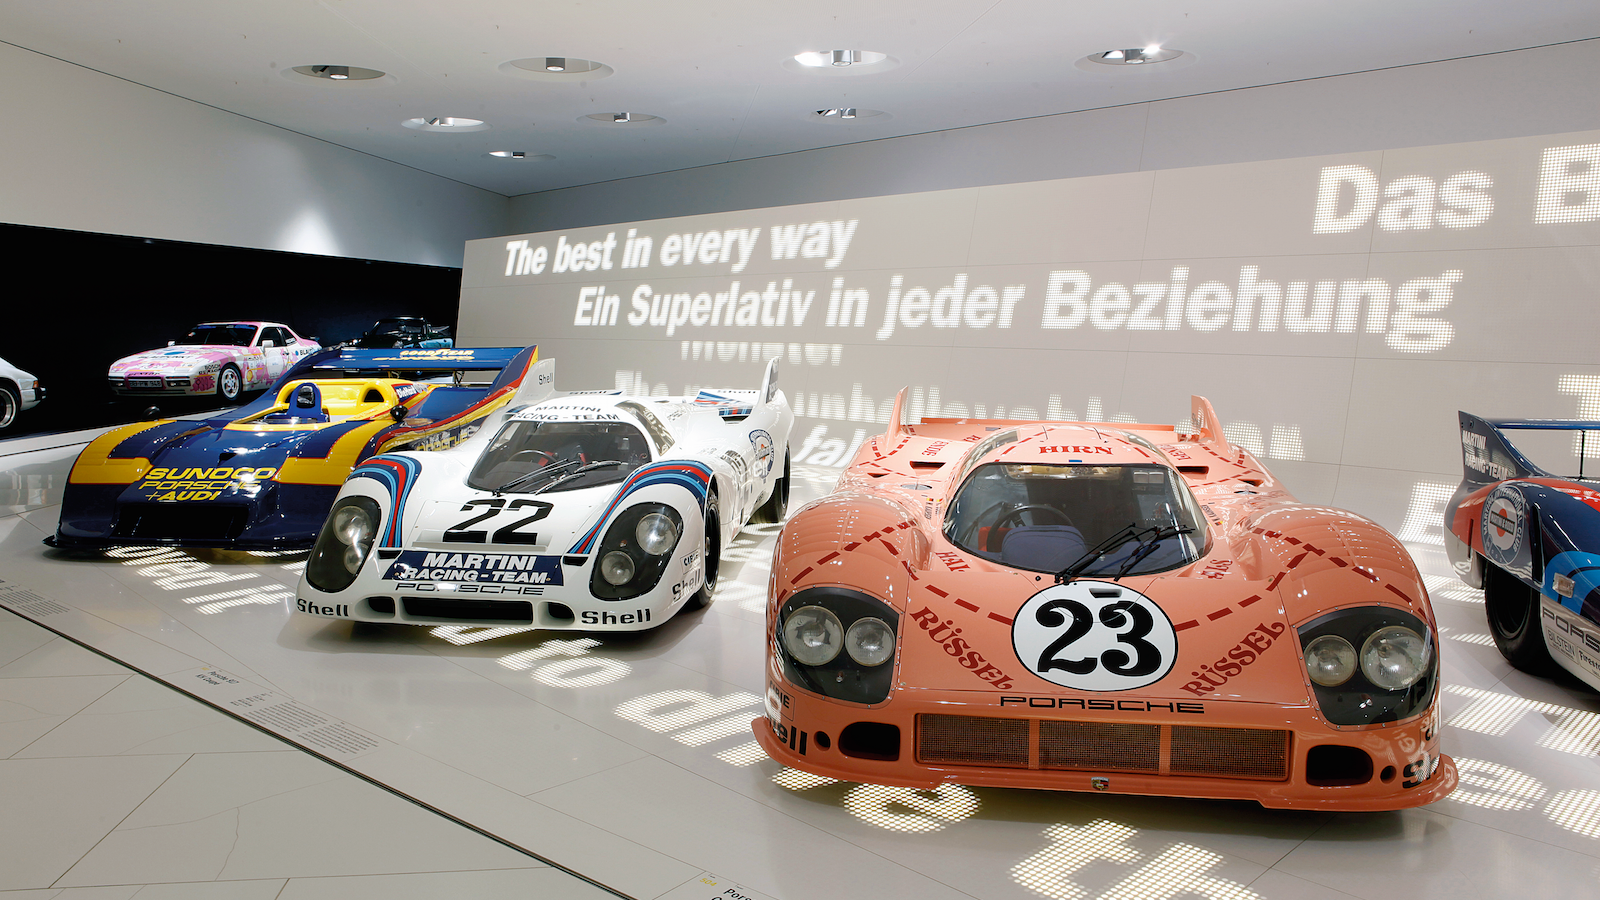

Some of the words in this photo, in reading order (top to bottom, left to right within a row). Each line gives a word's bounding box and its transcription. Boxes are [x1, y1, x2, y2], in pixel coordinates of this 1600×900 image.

[1312, 164, 1495, 234] Das
[504, 240, 548, 277] The
[552, 232, 616, 274] best
[621, 228, 653, 269] in
[660, 226, 761, 273] every
[770, 219, 859, 269] way
[574, 286, 620, 326] Ein
[627, 278, 815, 337] Superlativ
[825, 276, 869, 327] in
[875, 273, 1026, 341] jeder
[1040, 264, 1463, 353] Beziehung
[538, 374, 554, 386] Shell
[535, 405, 602, 413] MARTINI
[1462, 430, 1487, 450] MARTINI
[1038, 444, 1113, 456] HIRN
[145, 467, 278, 480] SUNOCO
[138, 480, 261, 490] PORSCHE
[443, 499, 552, 546] 22
[422, 552, 537, 571] MARTINI
[395, 583, 544, 595] POSCHE
[296, 599, 349, 617] Shell
[581, 608, 651, 625] Shell
[909, 606, 1014, 689] RÜSSEL
[1034, 599, 1161, 678] 23
[1547, 629, 1575, 656] BILSTEIN
[1179, 621, 1285, 697] RÜSSEL
[1000, 696, 1205, 714] PORSCHE
